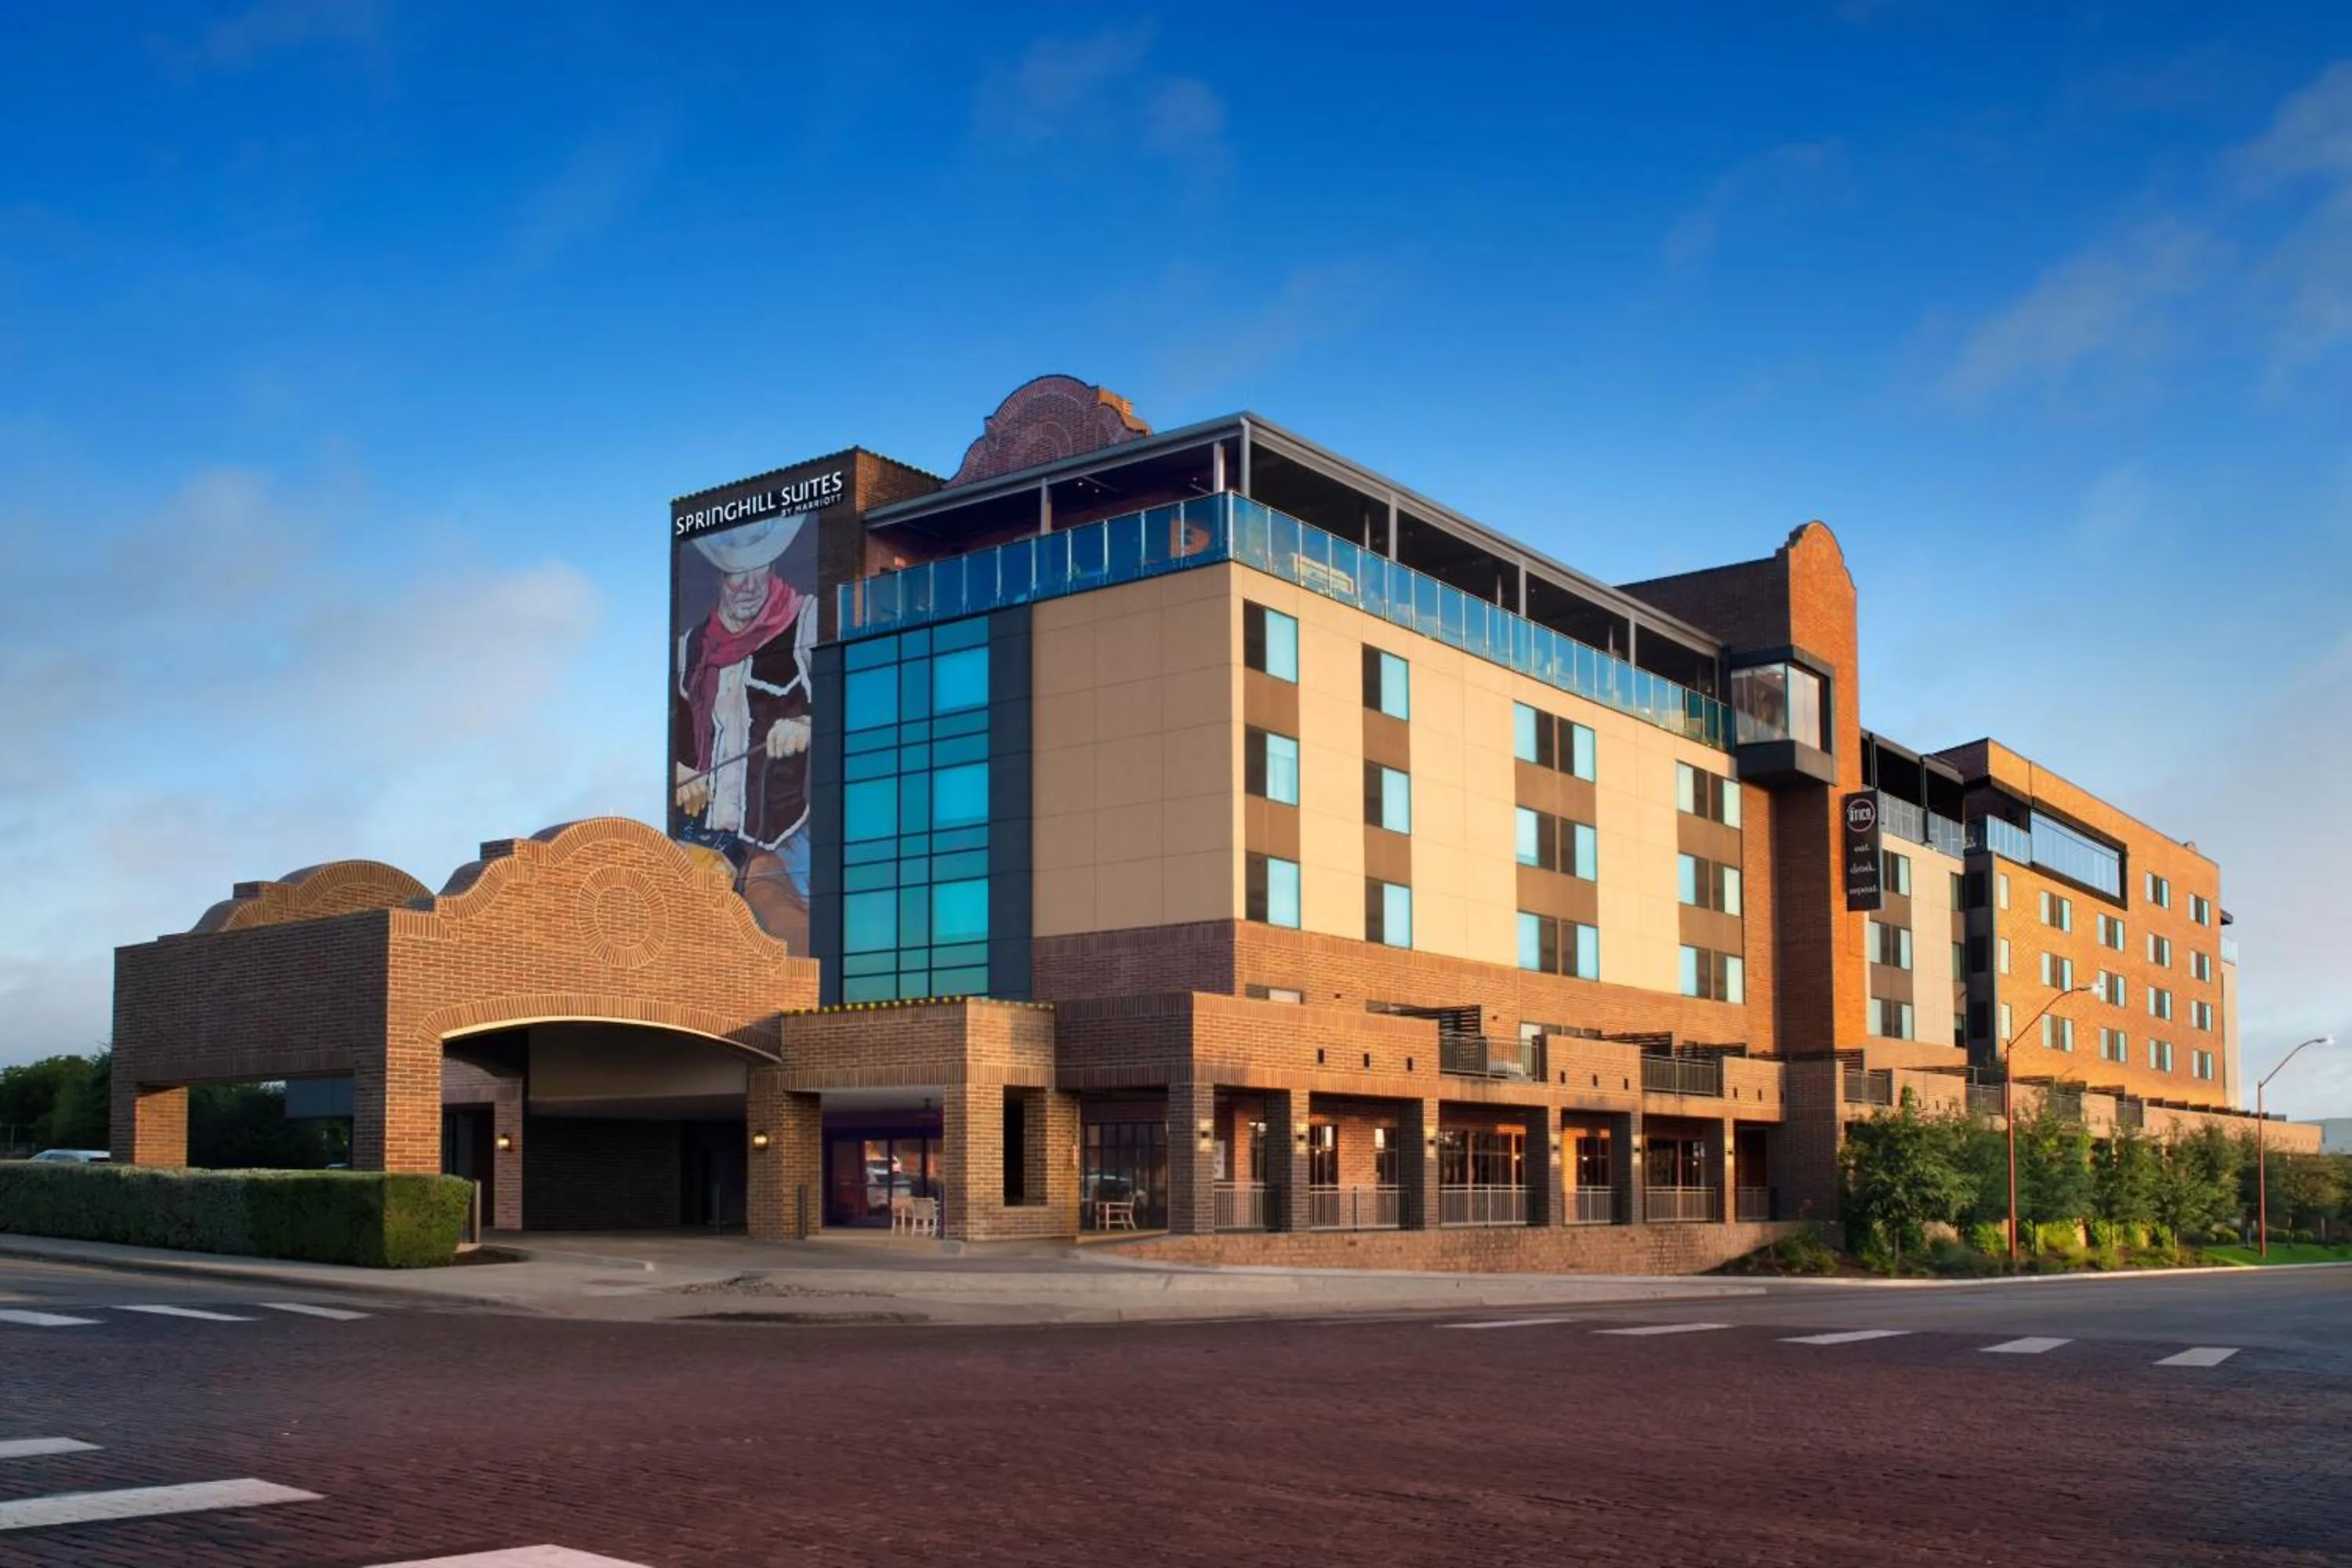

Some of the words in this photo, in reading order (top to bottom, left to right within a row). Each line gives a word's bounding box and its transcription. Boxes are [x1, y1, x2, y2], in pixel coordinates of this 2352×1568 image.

[676, 492, 776, 535] SPRINGHILL
[782, 471, 842, 506] SUITES
[782, 506, 792, 517] BY
[795, 494, 841, 514] MARRIOTT
